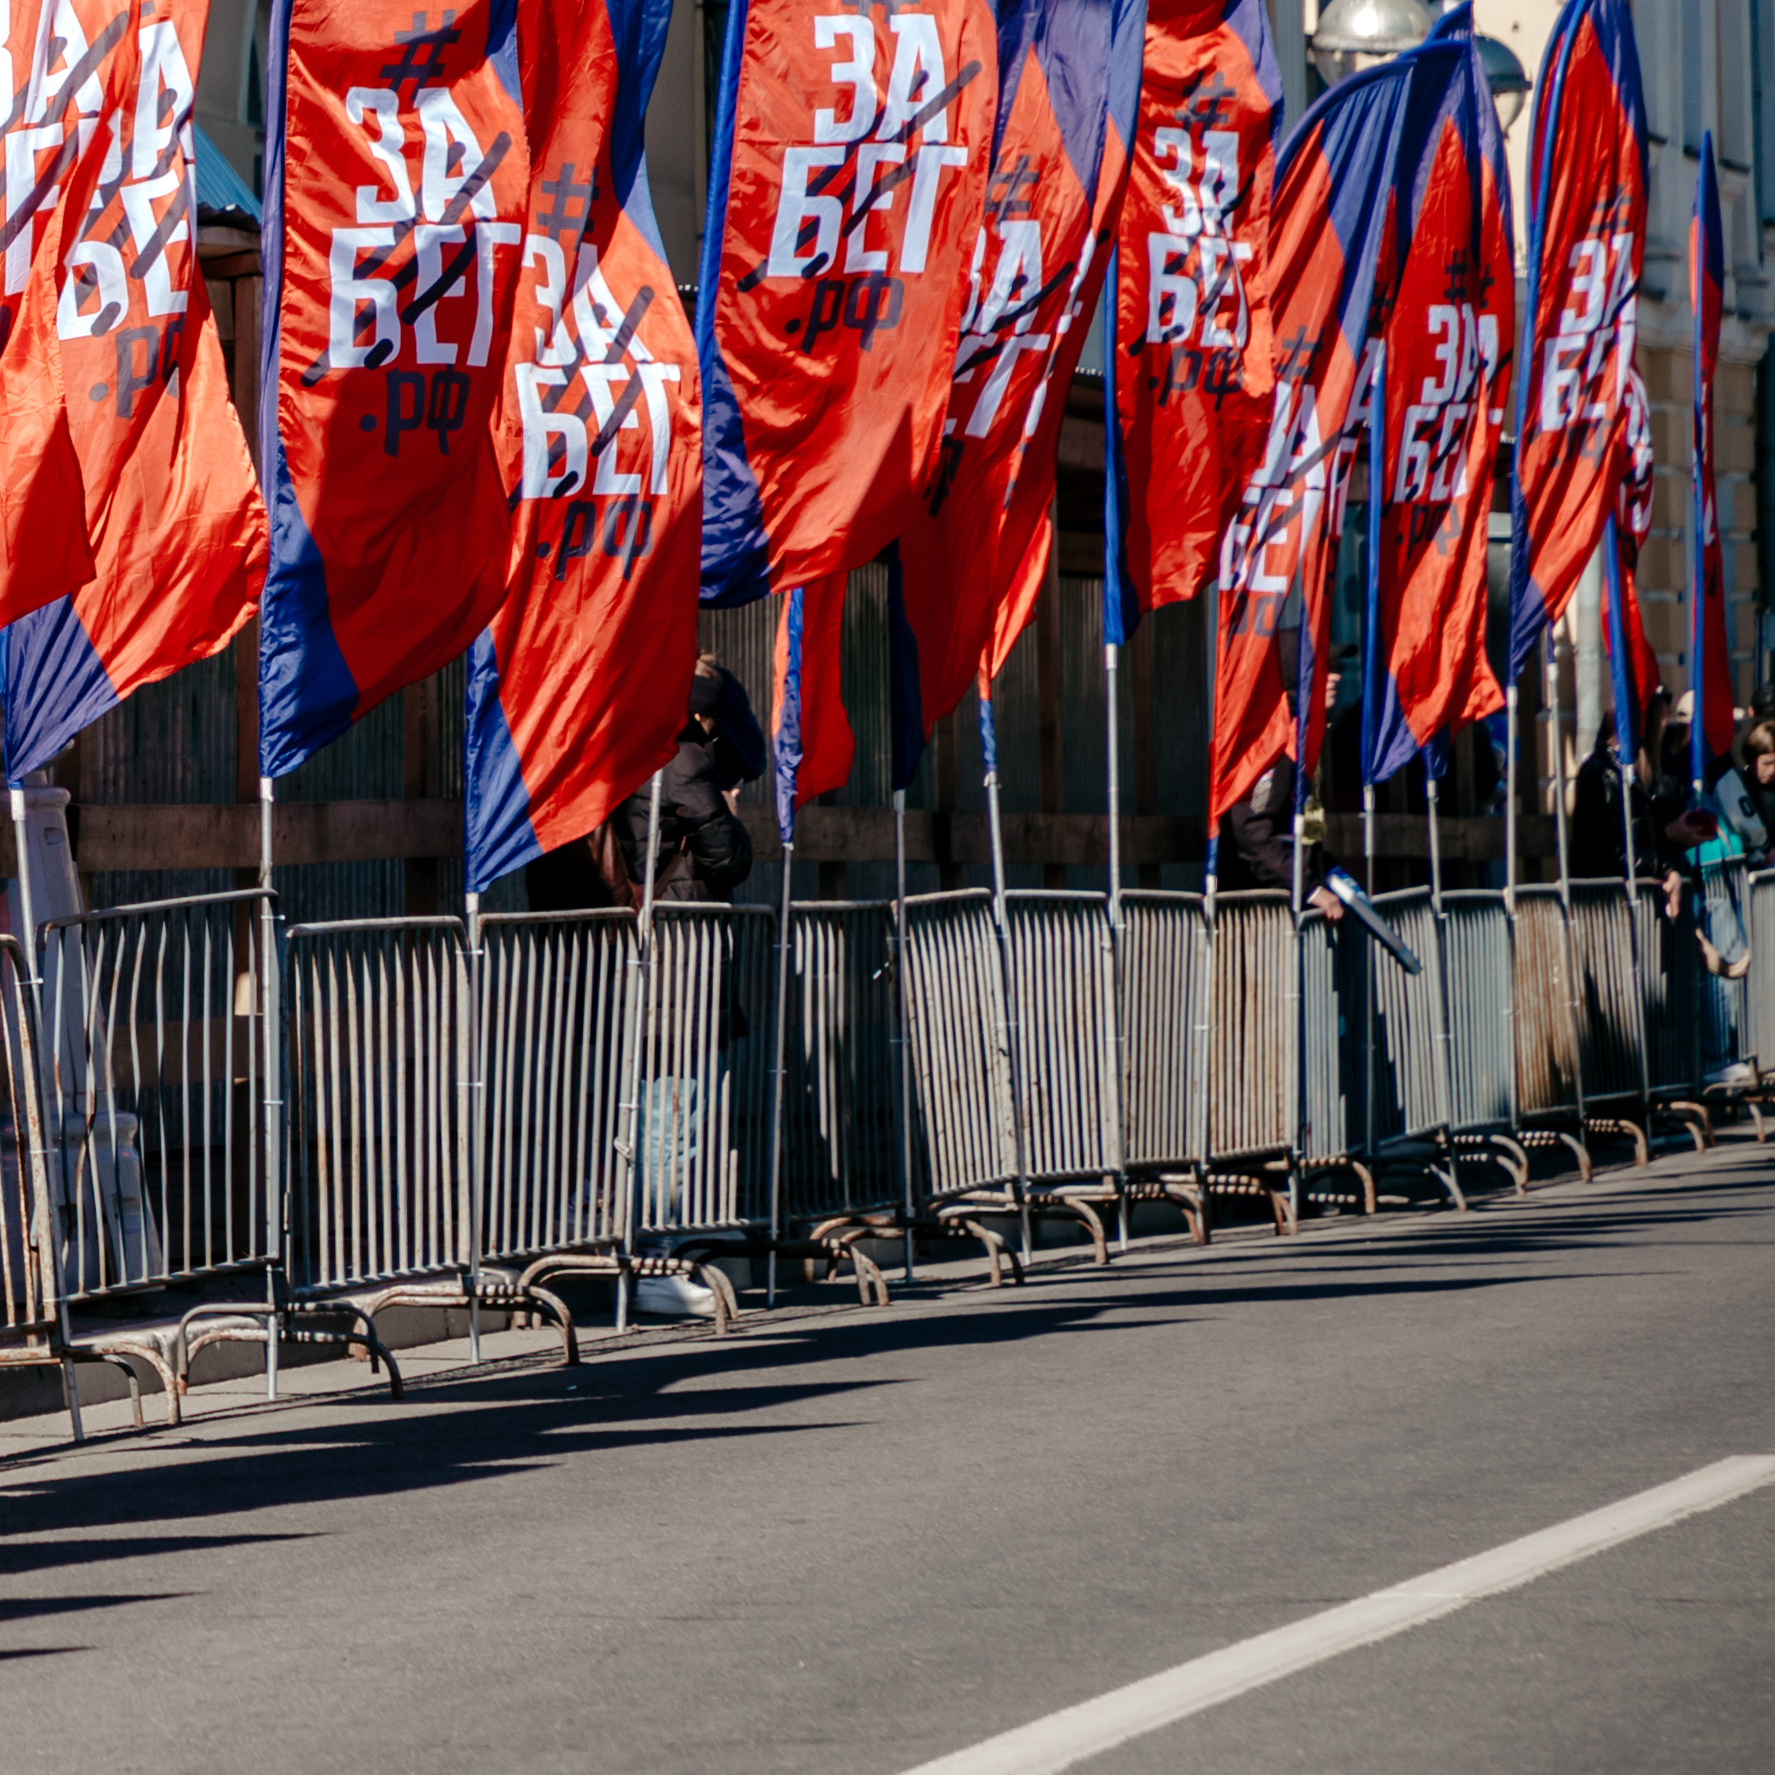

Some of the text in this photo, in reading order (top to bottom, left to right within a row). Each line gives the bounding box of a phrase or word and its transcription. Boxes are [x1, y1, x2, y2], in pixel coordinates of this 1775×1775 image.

[813, 13, 948, 144] ЗА
[345, 87, 496, 225] ЗА
[766, 146, 967, 277] БЕГ
[1154, 126, 1239, 237] ЗА
[329, 222, 520, 369] БЕГ
[521, 233, 653, 366] ЗА
[515, 362, 680, 499] БЕГ
